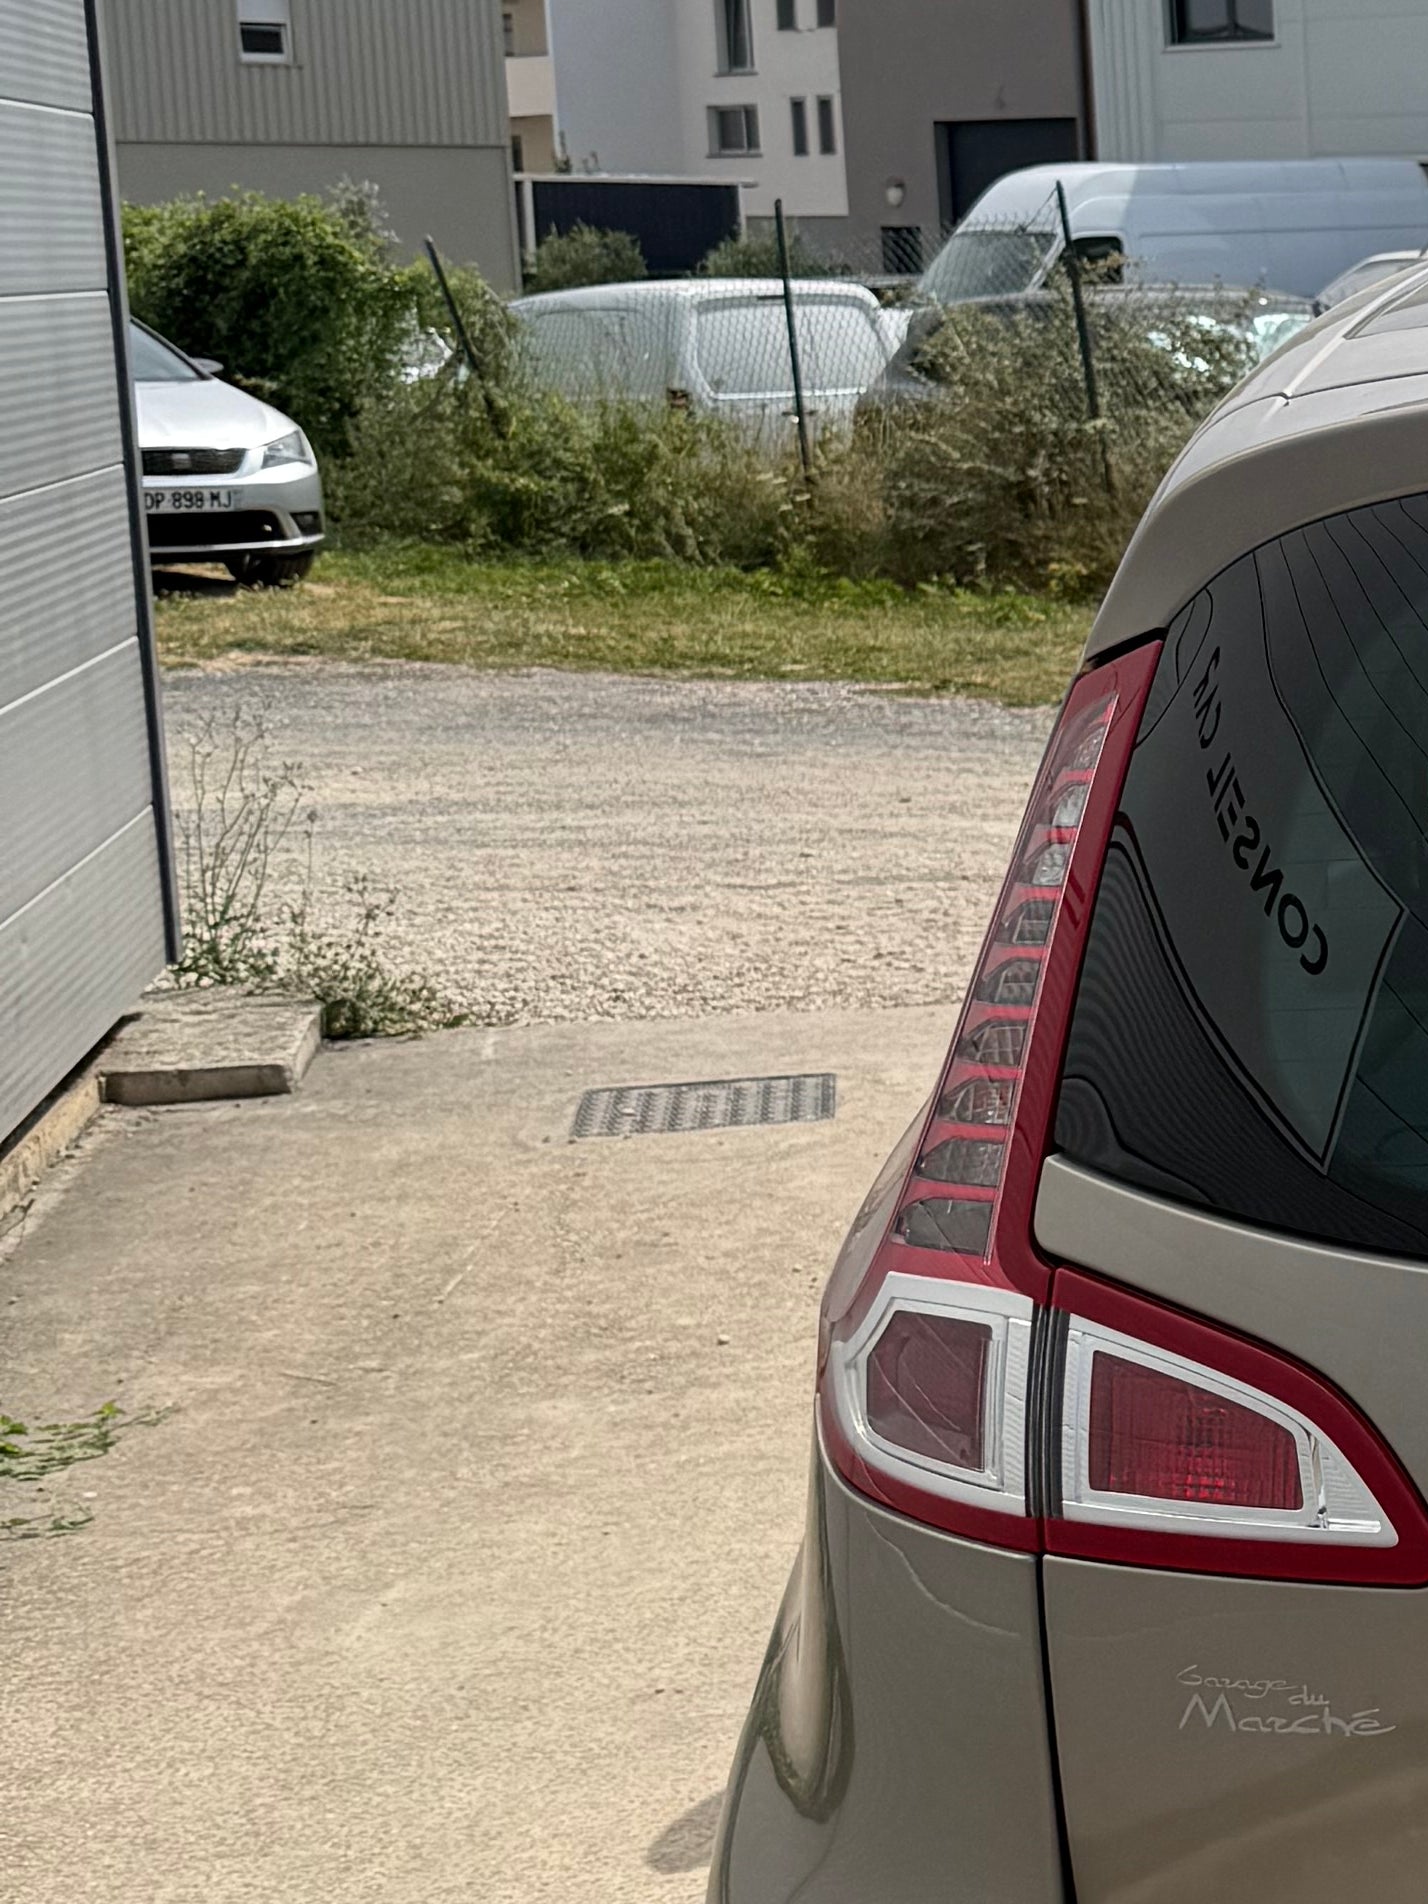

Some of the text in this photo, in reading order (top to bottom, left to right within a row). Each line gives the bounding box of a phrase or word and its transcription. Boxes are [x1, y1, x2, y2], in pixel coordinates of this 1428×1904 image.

[171, 490, 204, 509] 898
[1176, 1664, 1330, 1705] Garage du
[1178, 1693, 1396, 1736] Marché
